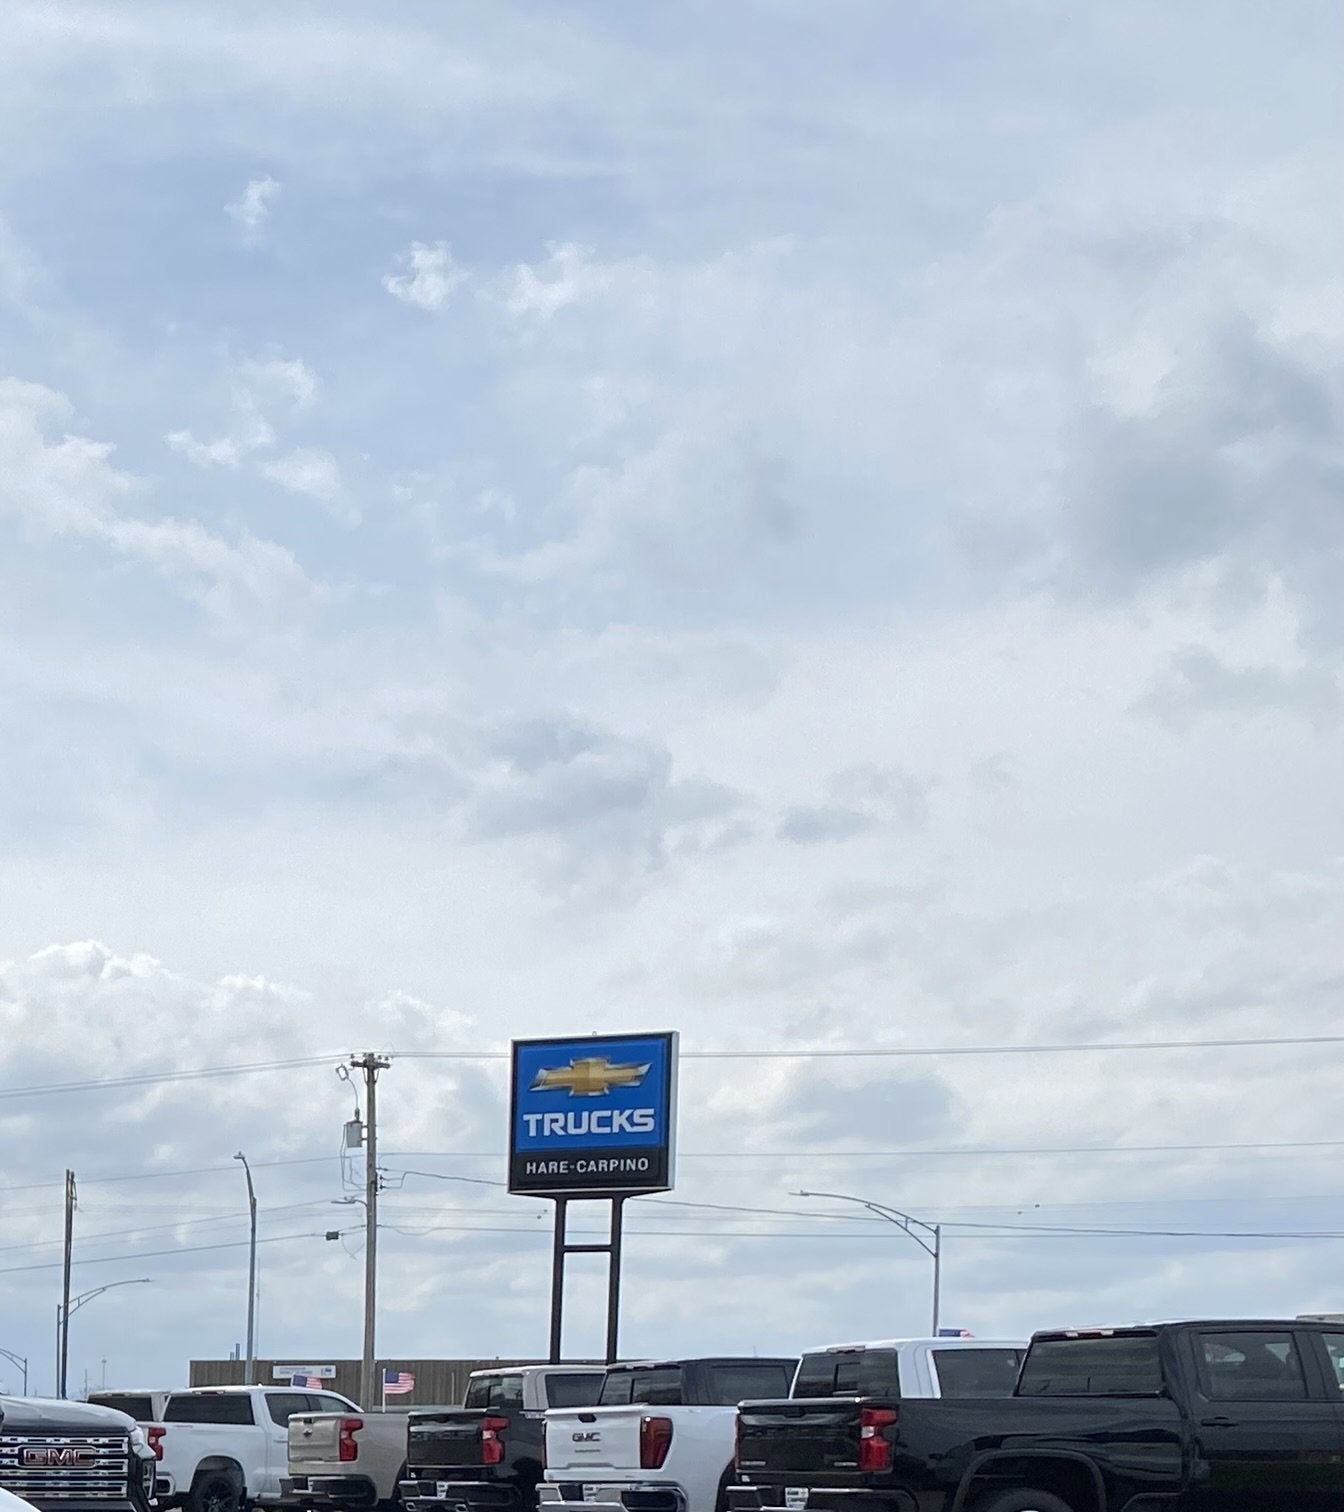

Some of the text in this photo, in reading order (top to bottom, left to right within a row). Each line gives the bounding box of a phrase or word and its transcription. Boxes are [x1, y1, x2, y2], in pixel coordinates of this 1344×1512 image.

[523, 1108, 655, 1137] TRUCKS
[525, 1157, 650, 1175] HARE-CARPINO
[572, 1432, 601, 1442] GMC
[23, 1448, 96, 1466] GMC
